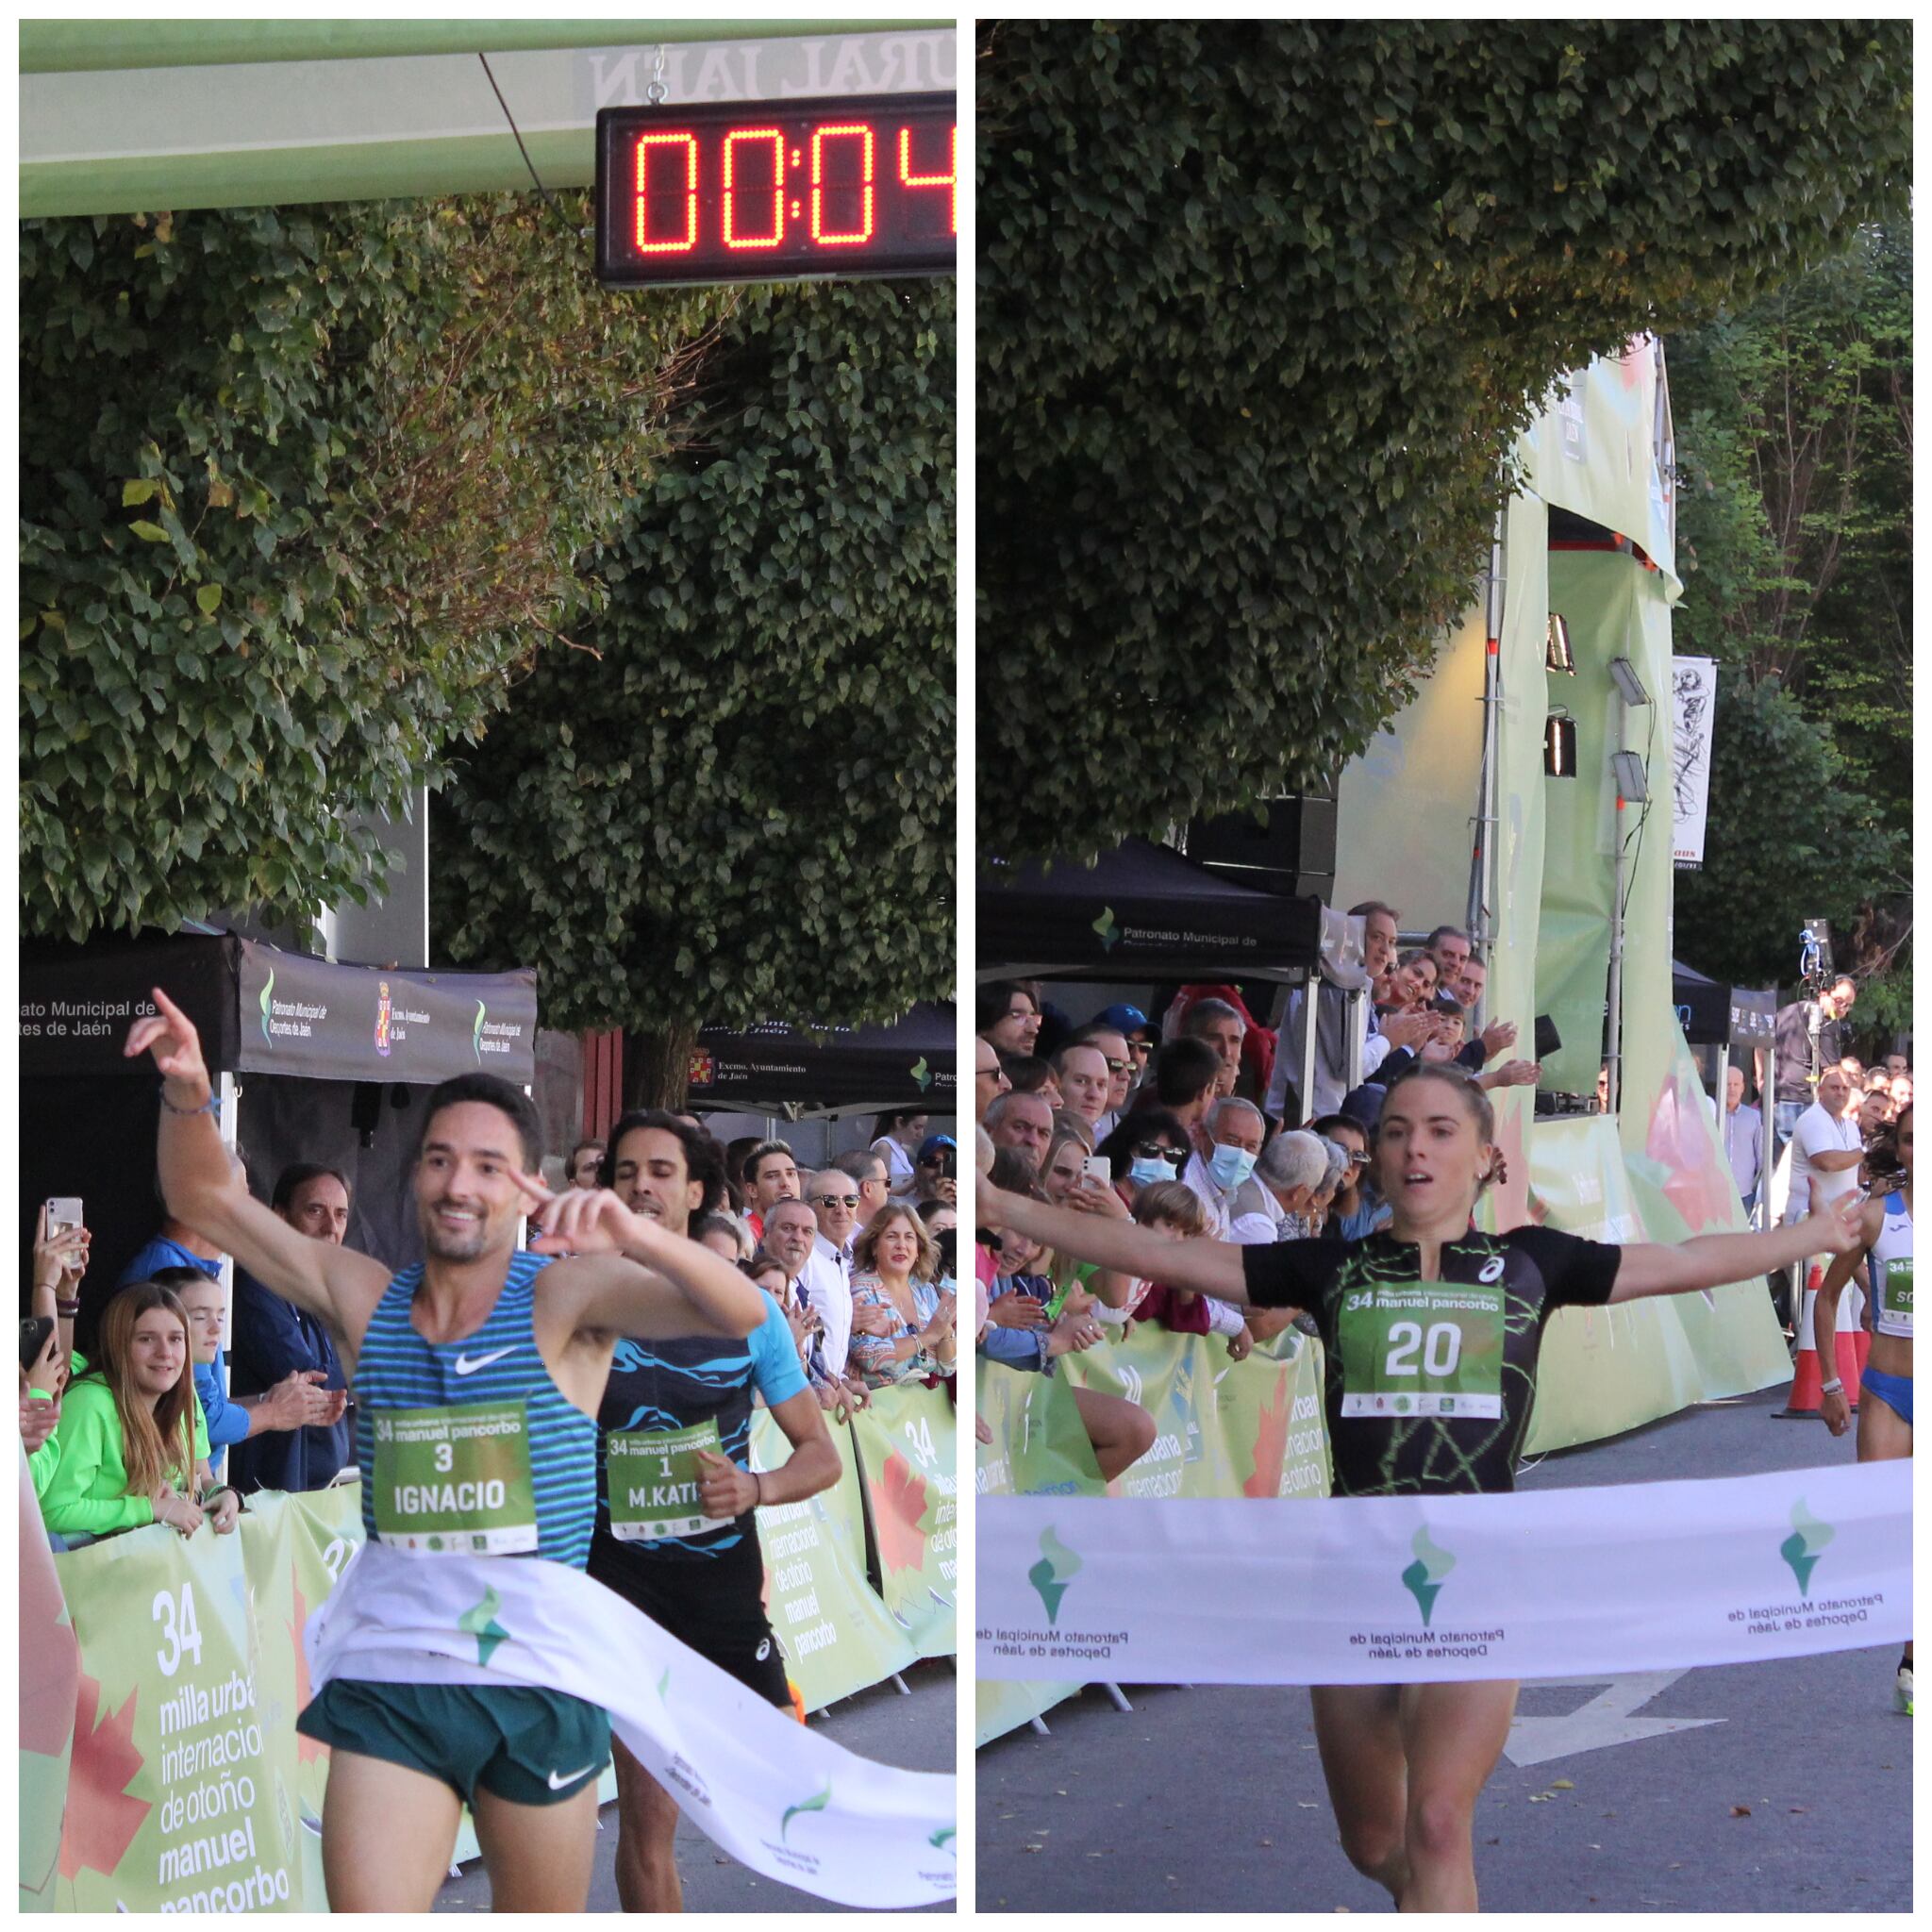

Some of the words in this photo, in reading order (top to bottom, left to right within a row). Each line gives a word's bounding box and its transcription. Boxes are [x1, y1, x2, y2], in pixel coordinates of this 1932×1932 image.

[1124, 927, 1179, 941] Patronato
[1183, 931, 1239, 946] Municipal
[1241, 936, 1257, 947] de
[51, 1001, 130, 1020] Municipal
[135, 1000, 156, 1016] de
[47, 1021, 67, 1036] de
[72, 1020, 111, 1036] Jaén
[718, 1072, 727, 1080] de
[728, 1072, 748, 1081] Jaén
[719, 1061, 748, 1071] Excmo.
[751, 1063, 807, 1074] Ayuntamiento
[1890, 1261, 1905, 1273] 34
[1346, 1291, 1374, 1311] 34
[1376, 1296, 1429, 1308] manuel
[1432, 1297, 1499, 1312] pancorbo
[1385, 1322, 1462, 1376] 20
[377, 1420, 393, 1441] 34
[396, 1425, 449, 1442] manuel
[452, 1421, 521, 1441] pancorbo
[906, 1417, 938, 1468] 34
[435, 1443, 453, 1472] 3
[610, 1439, 628, 1456] 34
[629, 1443, 669, 1457] manuel
[671, 1435, 716, 1456] pancorbo
[659, 1457, 673, 1477] 1
[394, 1479, 505, 1514] IGNACIO
[785, 1587, 820, 1624] manuel
[152, 1581, 202, 1676] 34
[794, 1618, 837, 1664] pancorbo
[160, 1683, 208, 1736] milla
[160, 1789, 185, 1835] de
[187, 1770, 256, 1825] otoño
[158, 1816, 257, 1885] manuel
